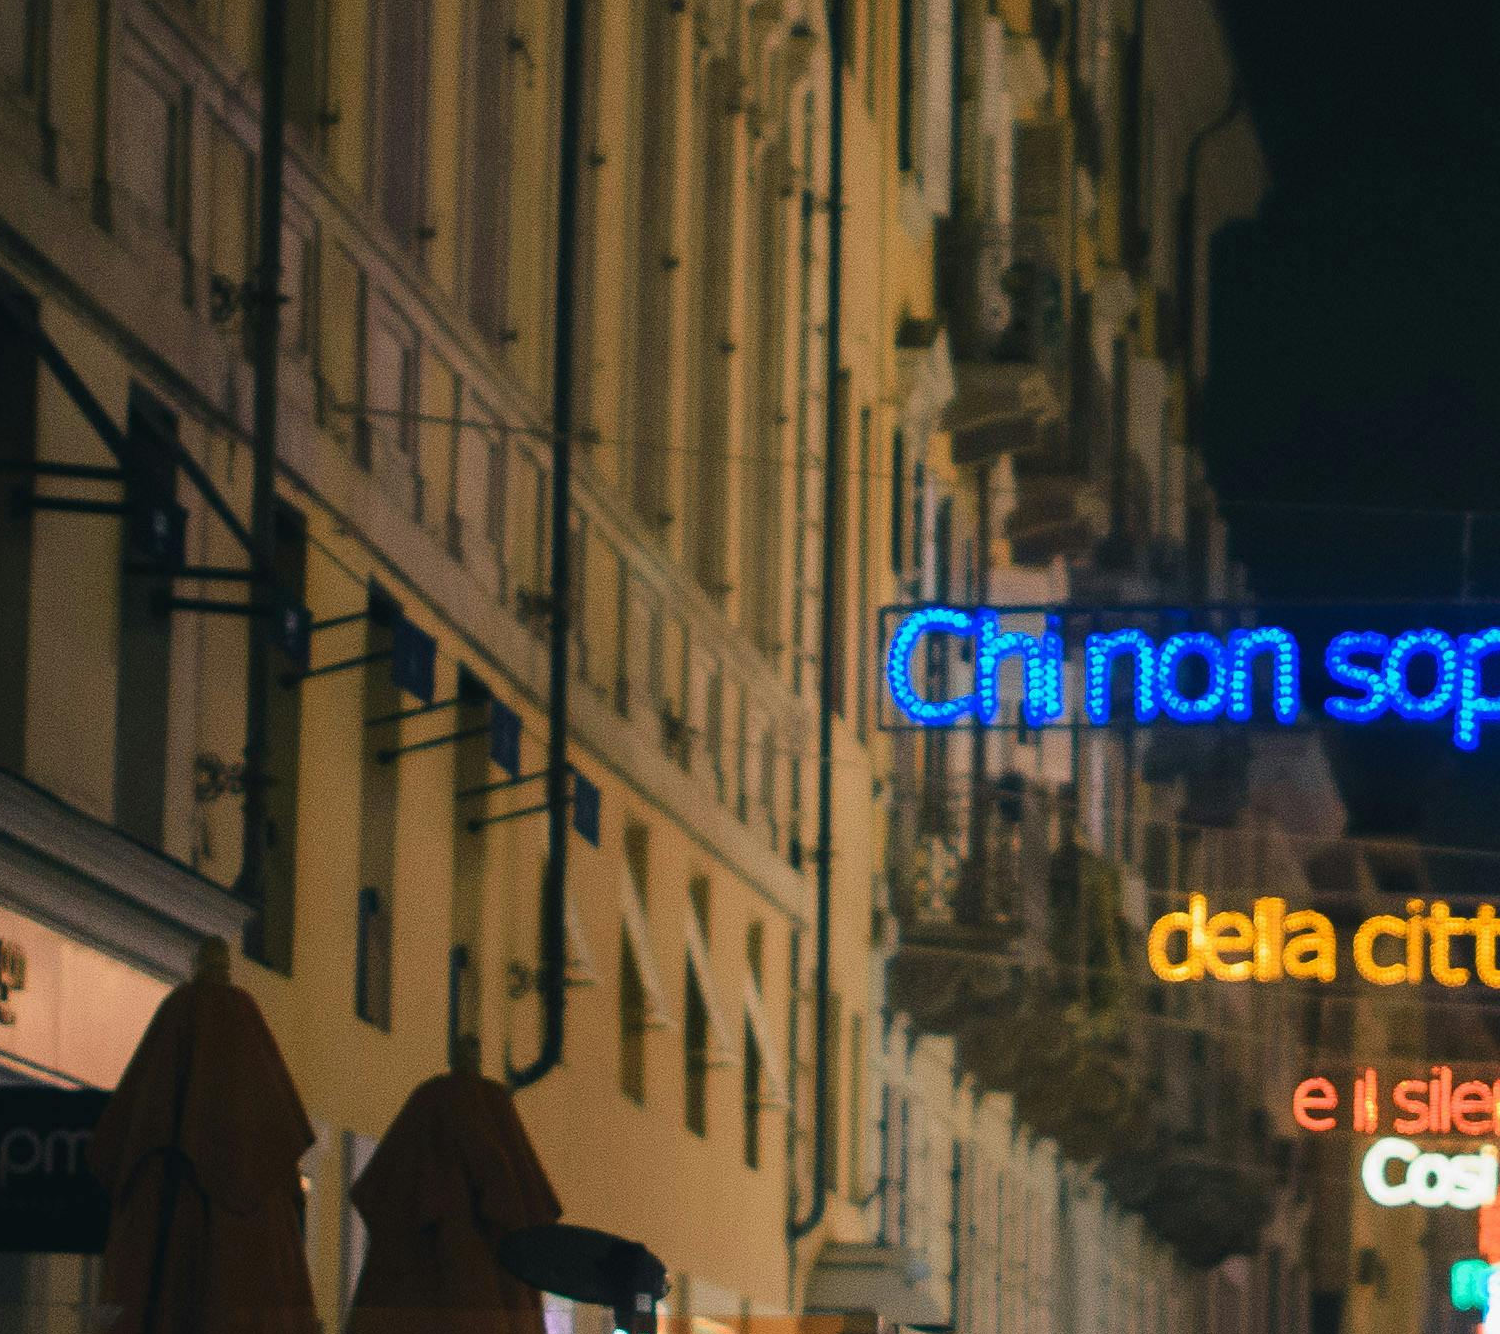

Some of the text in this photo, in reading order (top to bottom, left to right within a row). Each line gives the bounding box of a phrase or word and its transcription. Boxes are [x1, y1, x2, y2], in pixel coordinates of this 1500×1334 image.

[886, 606, 1065, 727] Chi
[1084, 625, 1299, 725] non
[1148, 892, 1335, 983] della
[1293, 1076, 1338, 1132] e
[1353, 1069, 1380, 1134] il
